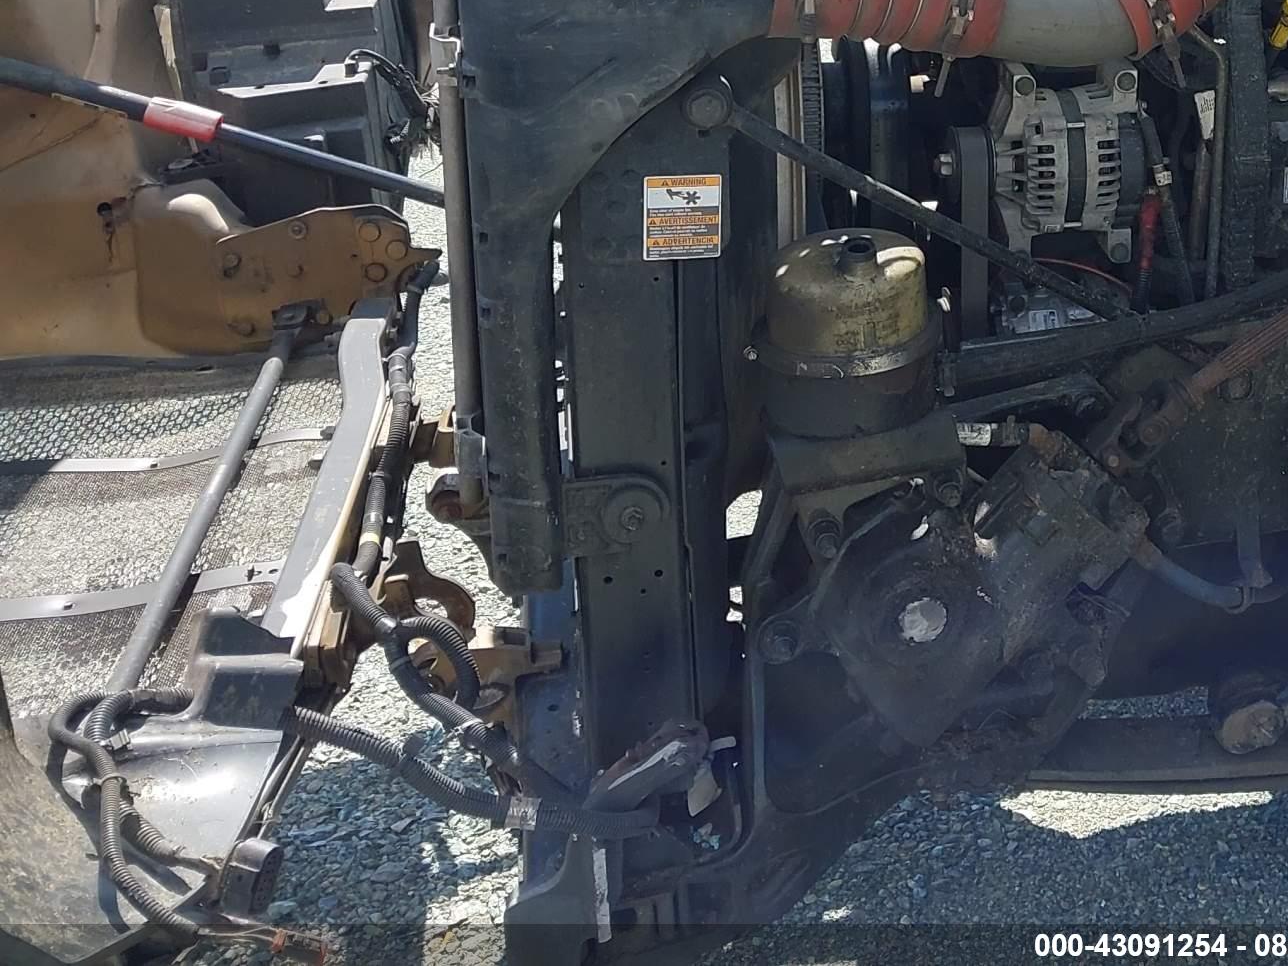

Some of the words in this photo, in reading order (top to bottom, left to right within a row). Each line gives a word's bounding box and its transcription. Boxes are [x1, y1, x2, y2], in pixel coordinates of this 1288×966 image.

[671, 177, 707, 186] WARNING
[659, 216, 717, 225] AVERTISSEMENT
[662, 237, 714, 245] ADVERTENCIA
